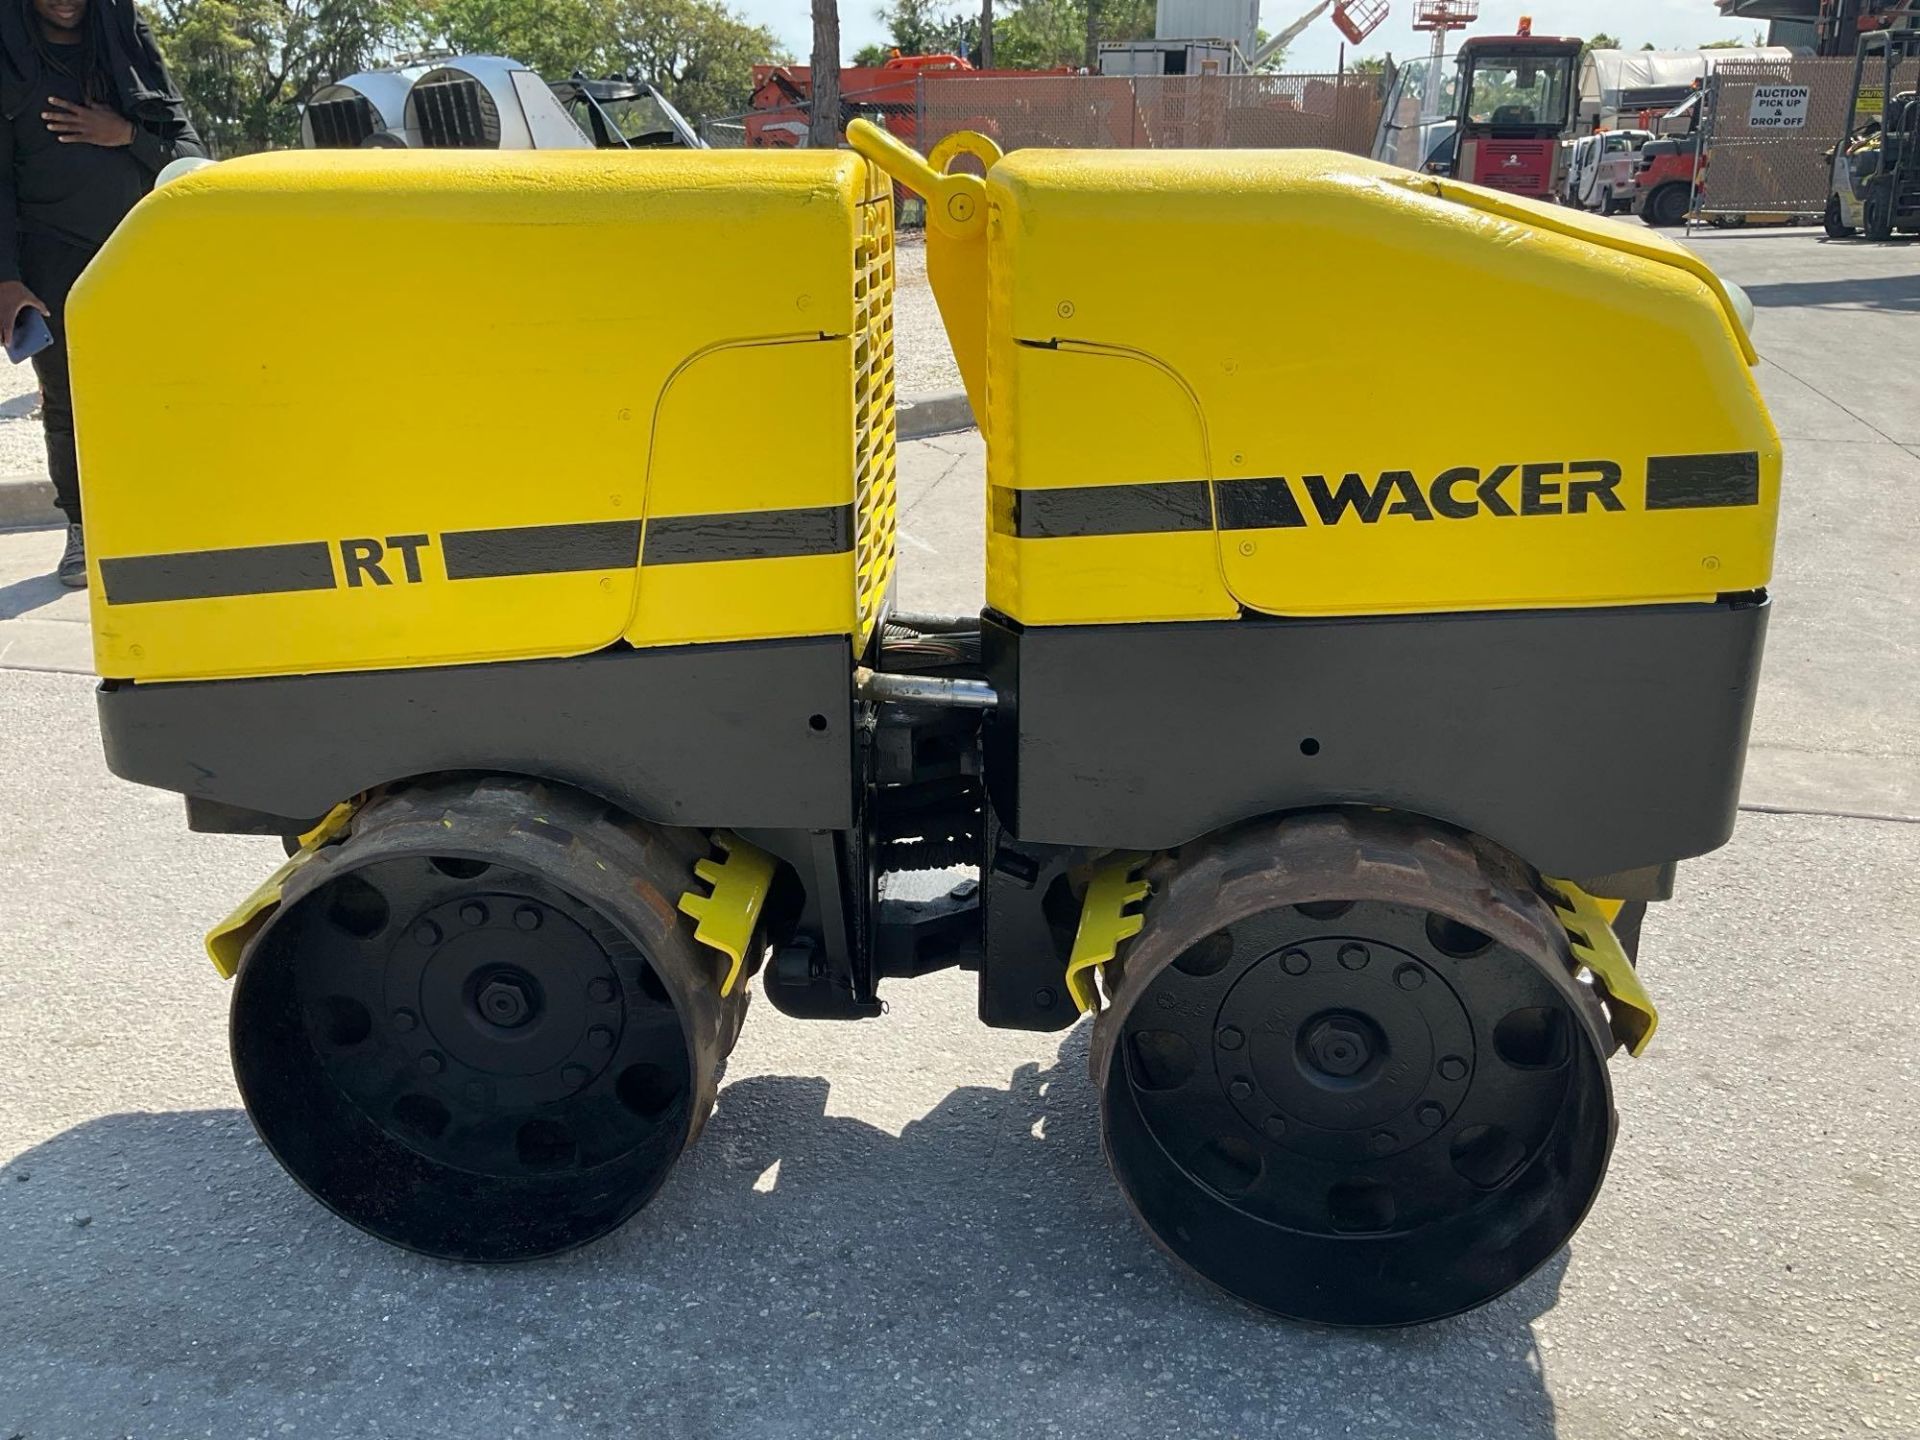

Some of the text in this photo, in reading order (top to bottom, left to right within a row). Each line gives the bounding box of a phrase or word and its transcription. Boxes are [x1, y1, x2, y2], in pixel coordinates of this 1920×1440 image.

[1755, 89, 1807, 97] AUCTION
[1858, 90, 1885, 98] CAUTIO
[1301, 460, 1626, 526] WACKER
[340, 534, 430, 588] RT
